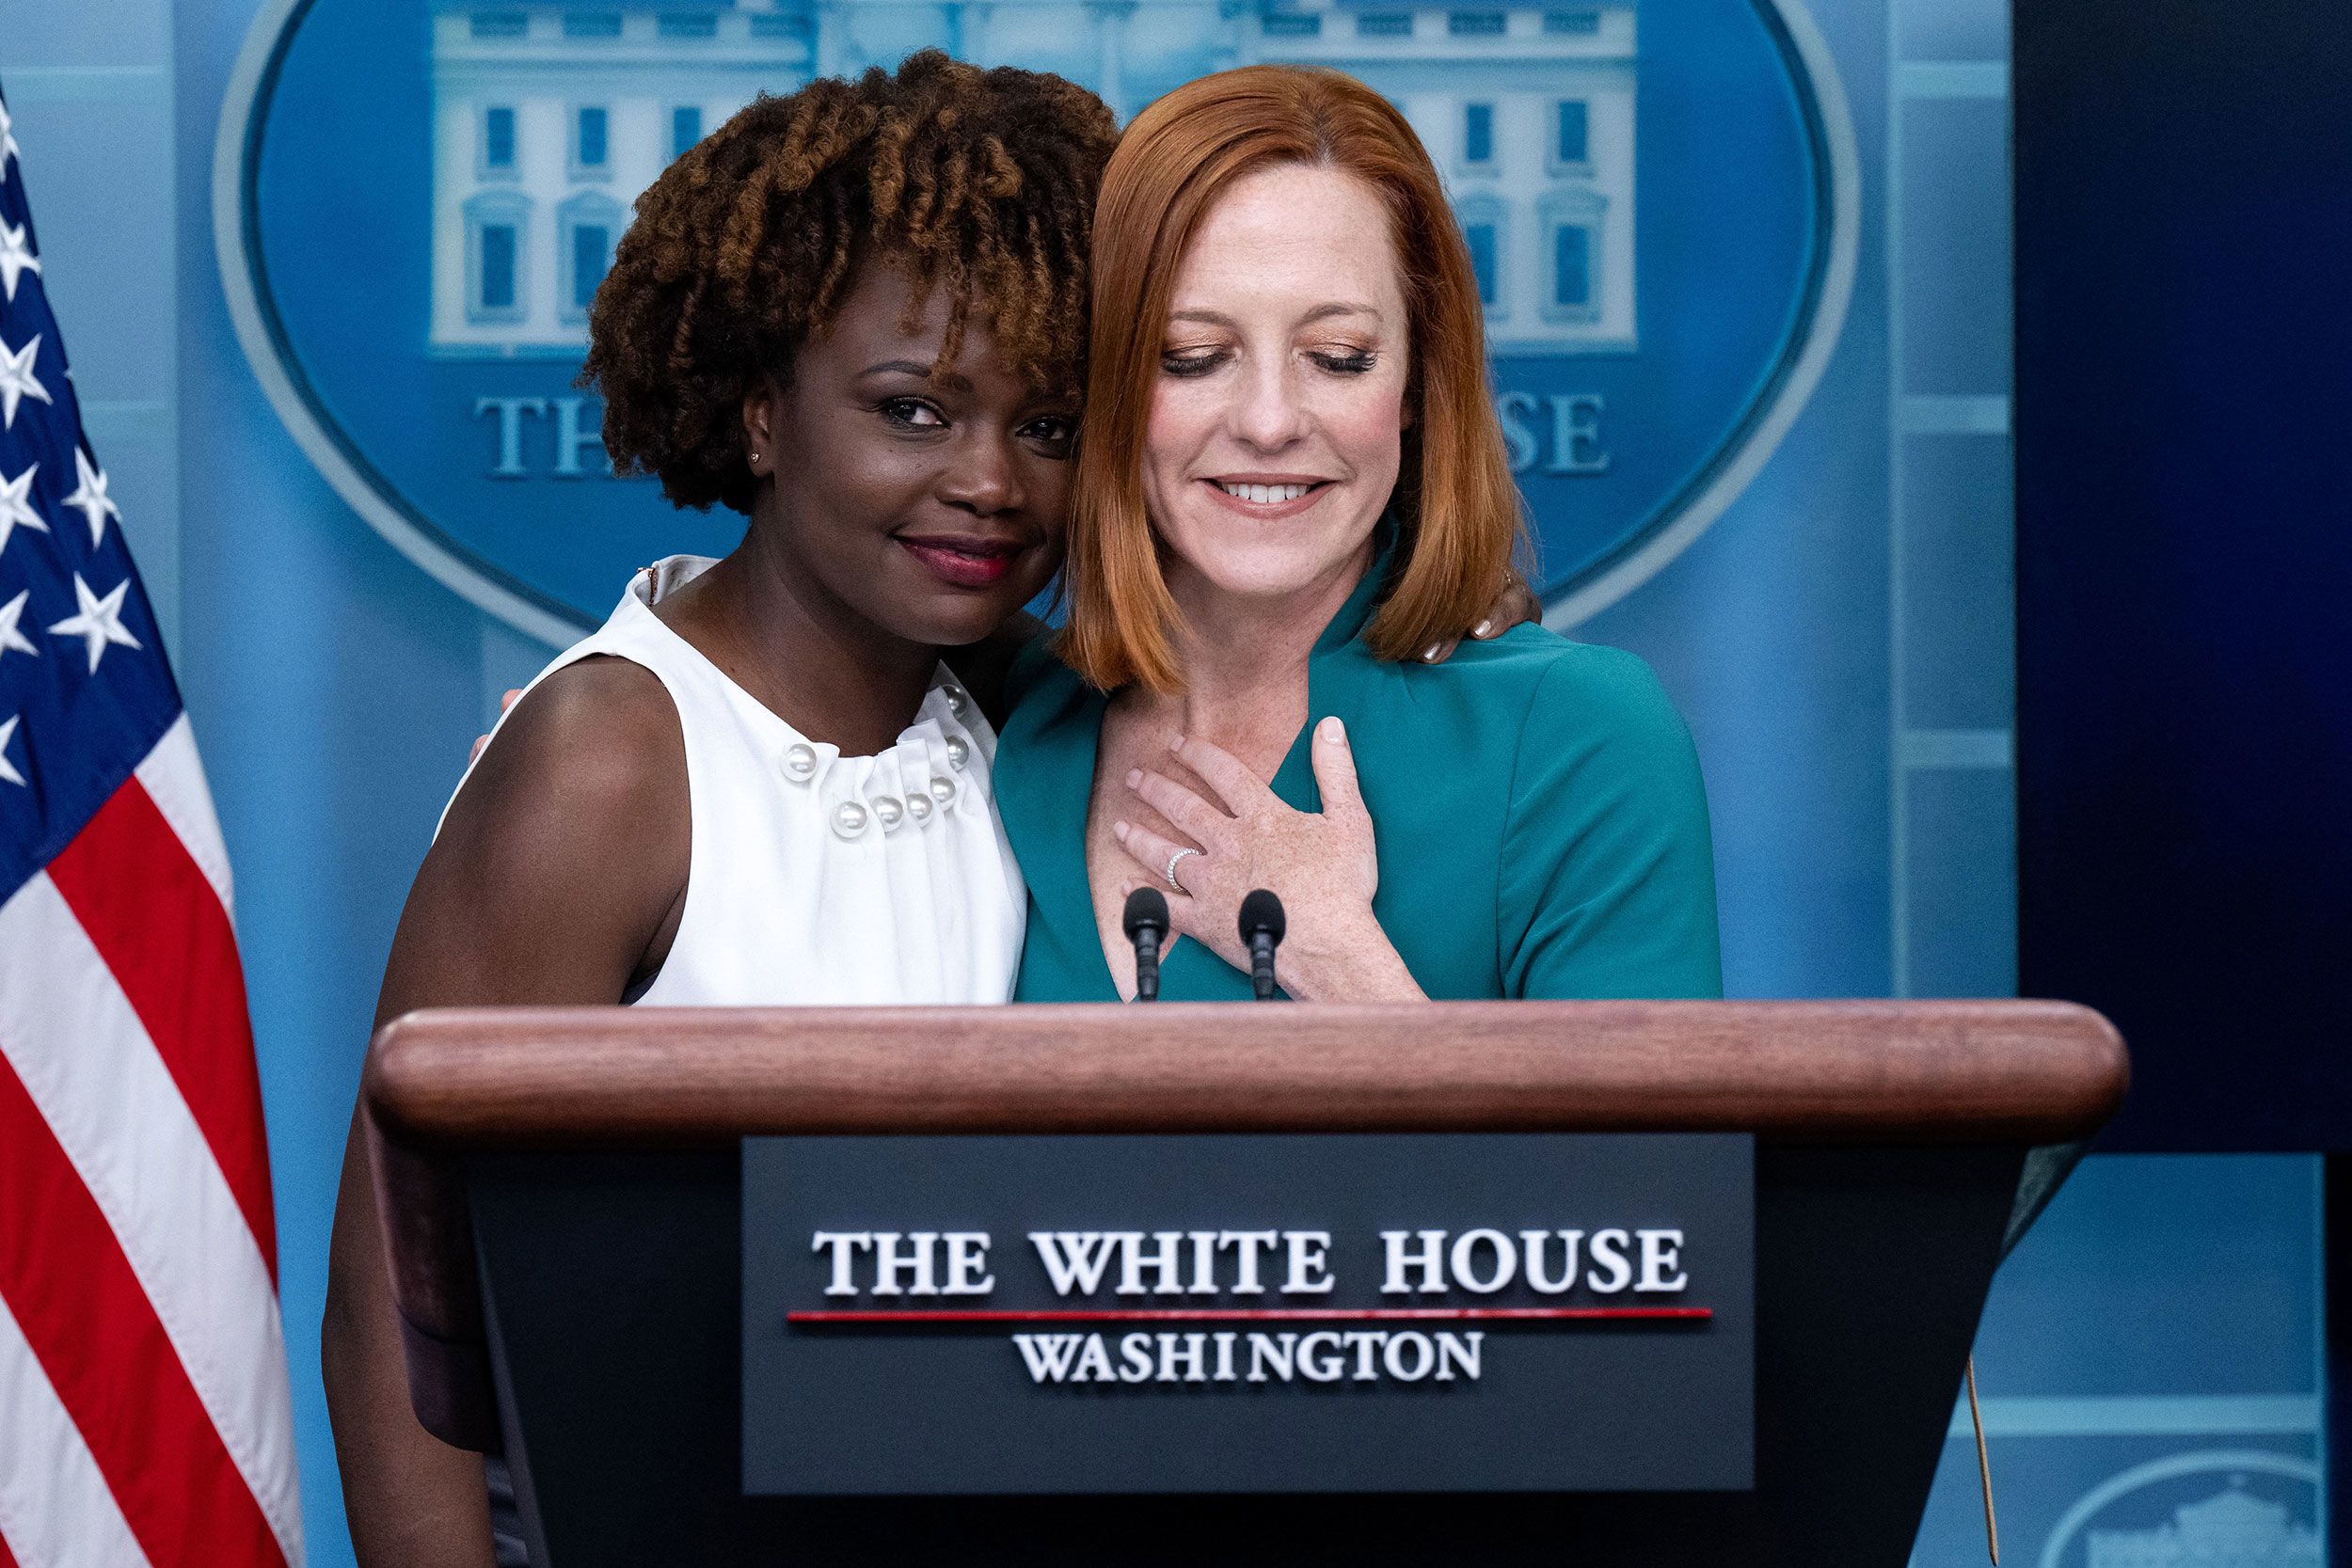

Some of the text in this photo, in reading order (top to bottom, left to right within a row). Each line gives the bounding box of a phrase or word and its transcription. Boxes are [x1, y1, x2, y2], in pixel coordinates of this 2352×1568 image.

[473, 396, 613, 475] TH
[812, 1227, 1689, 1296] THE WHITE HOUSE
[1012, 1331, 1485, 1383] WASHINGTON
